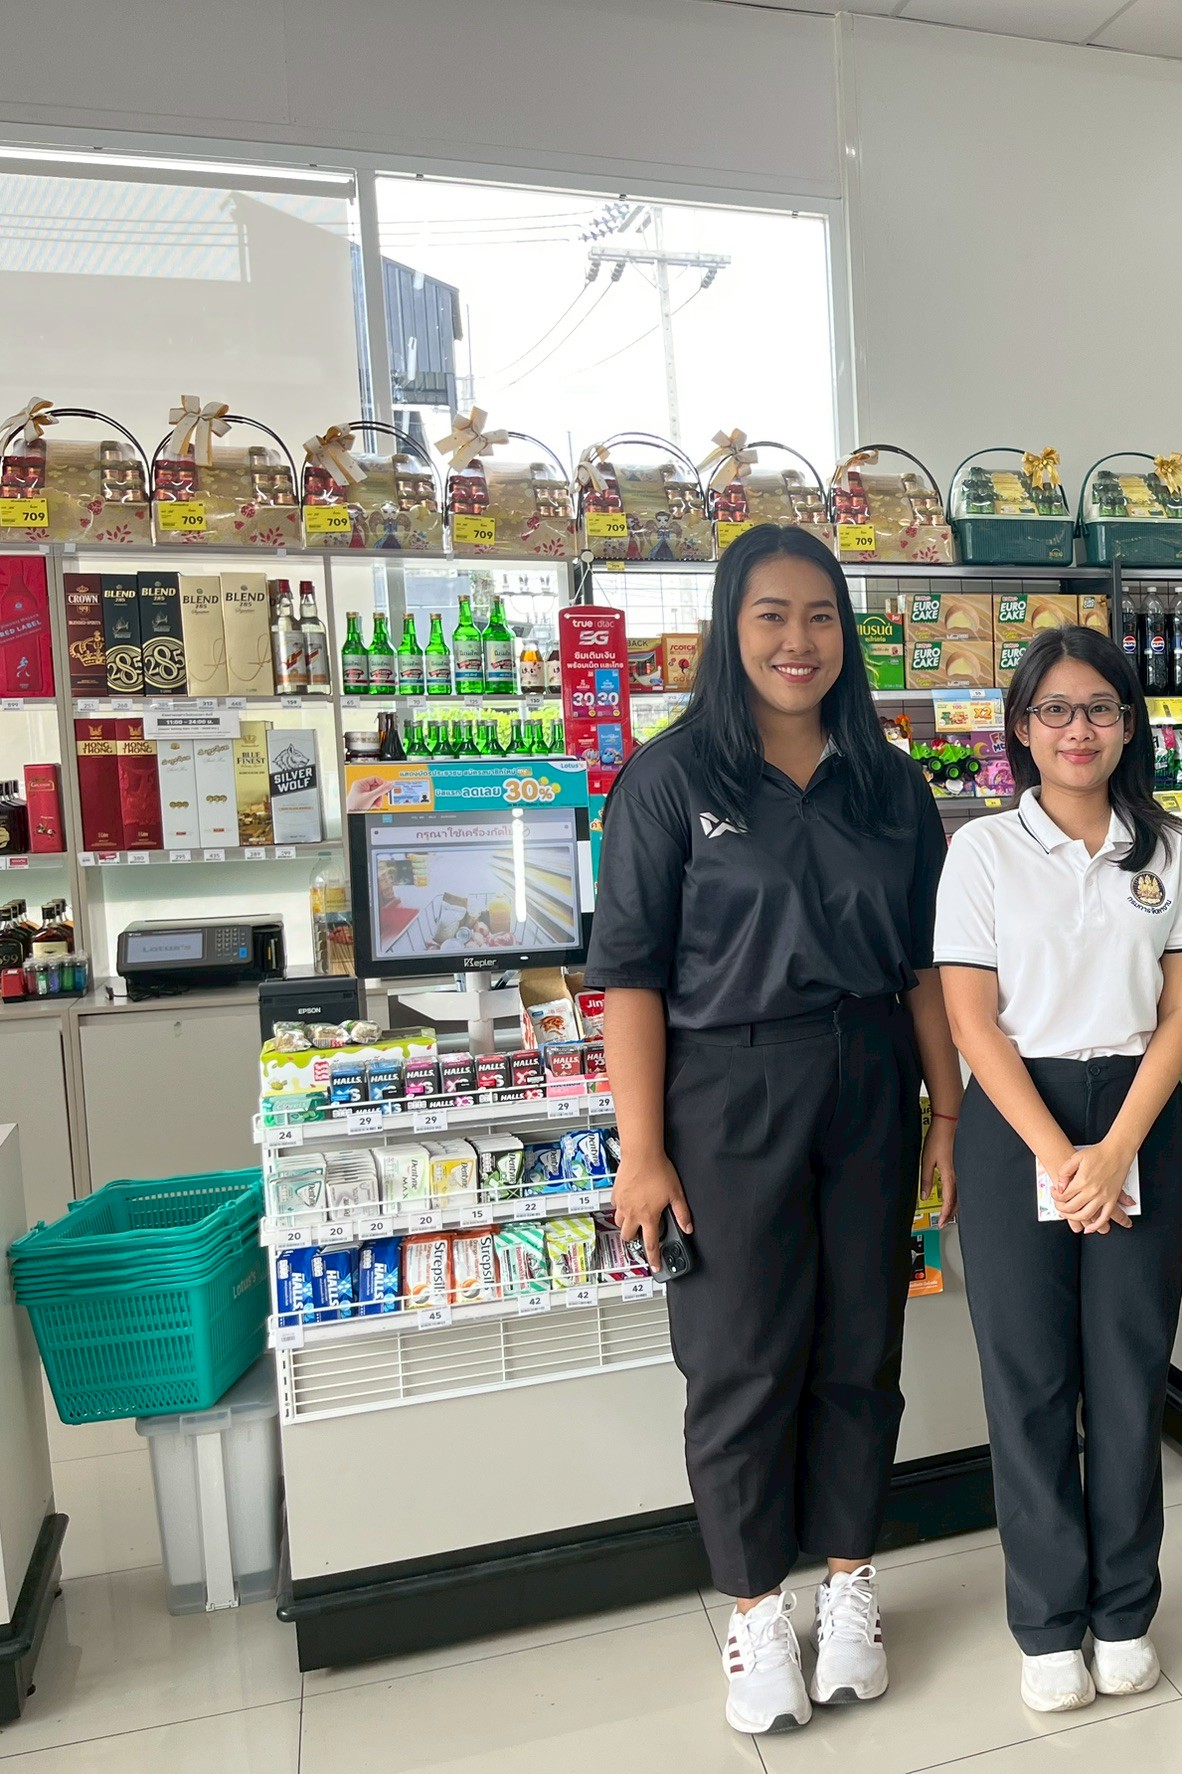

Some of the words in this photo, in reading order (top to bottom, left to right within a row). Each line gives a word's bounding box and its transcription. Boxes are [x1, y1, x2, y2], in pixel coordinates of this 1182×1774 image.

[23, 512, 45, 521] 709
[182, 516, 204, 525] 709
[327, 518, 348, 527] 709
[606, 524, 626, 532] 709
[474, 530, 494, 540] 709
[856, 537, 873, 546] 709
[104, 590, 136, 598] BLEND
[142, 587, 176, 596] BLEND
[68, 594, 99, 604] CROWN
[182, 596, 219, 604] BLEND
[225, 592, 265, 602] BLEND
[912, 600, 940, 612] EURO
[1000, 600, 1026, 612] EURO
[912, 610, 938, 621] CAKE
[999, 610, 1025, 621] CAKE
[17, 620, 42, 632] LABEL
[914, 648, 940, 660] EURO
[107, 652, 142, 684] 285
[144, 646, 184, 680] 285
[912, 658, 939, 669] CAKE
[1001, 658, 1021, 670] CAK
[274, 768, 312, 784] SILVER
[277, 778, 310, 793] WOLF
[463, 787, 500, 798] ลดเลย
[505, 779, 554, 802] 30%
[464, 958, 497, 969] Kepler
[587, 1052, 604, 1060] HALL
[478, 1062, 506, 1072] HALLS
[513, 1058, 540, 1068] HALLS
[406, 1070, 434, 1078] HALLS
[444, 1066, 472, 1076] HALLS
[334, 1076, 362, 1086] HALLS
[370, 1073, 400, 1082] HALLS
[500, 1093, 524, 1101] HALLS
[598, 1098, 610, 1106] 29
[430, 1100, 454, 1108] HALLS
[360, 1118, 372, 1126] 29
[425, 1116, 438, 1124] 29
[280, 1132, 292, 1140] 24
[508, 1153, 516, 1184] Dentyne
[580, 1196, 590, 1204] 15
[524, 1203, 536, 1211] 22
[420, 1216, 432, 1224] 20
[370, 1222, 384, 1230] 20
[288, 1232, 301, 1240] 20
[330, 1228, 343, 1236] 20
[480, 1236, 494, 1290] Strepsil
[430, 1242, 446, 1297] Strepsil
[374, 1262, 387, 1300] HALLS
[292, 1272, 305, 1311] HALLS
[326, 1270, 340, 1307] HALLS
[577, 1291, 589, 1299] 42
[530, 1297, 541, 1305] 42
[429, 1312, 442, 1320] 45
